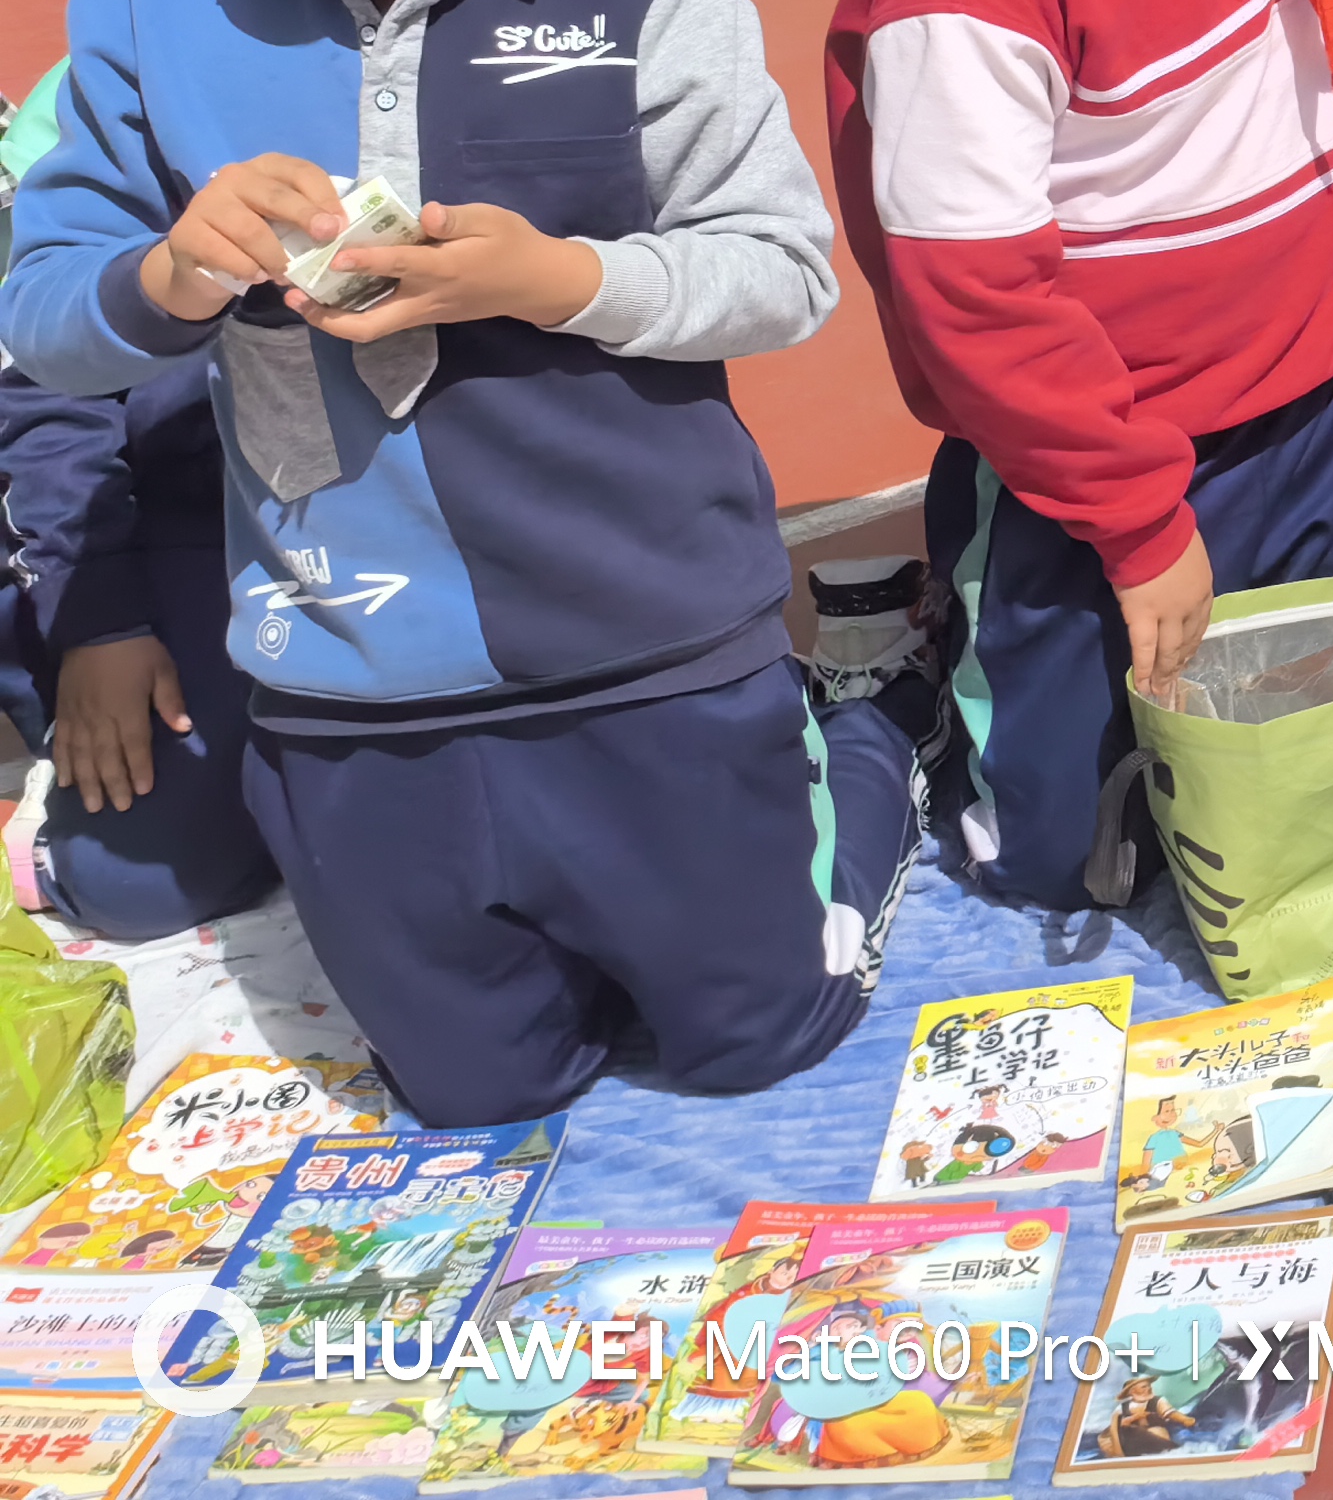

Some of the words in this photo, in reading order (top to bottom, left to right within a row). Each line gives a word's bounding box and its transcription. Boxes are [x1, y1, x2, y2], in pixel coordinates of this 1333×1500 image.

[963, 1049, 1060, 1088] 上学记
[1197, 1043, 1312, 1080] 小头爸爸
[163, 1080, 312, 1130] 米小圈
[179, 1108, 321, 1150] 上学记
[296, 1153, 411, 1192] 贵州
[920, 1255, 1041, 1283] 三国演义
[1135, 1257, 1319, 1298] 老人与海
